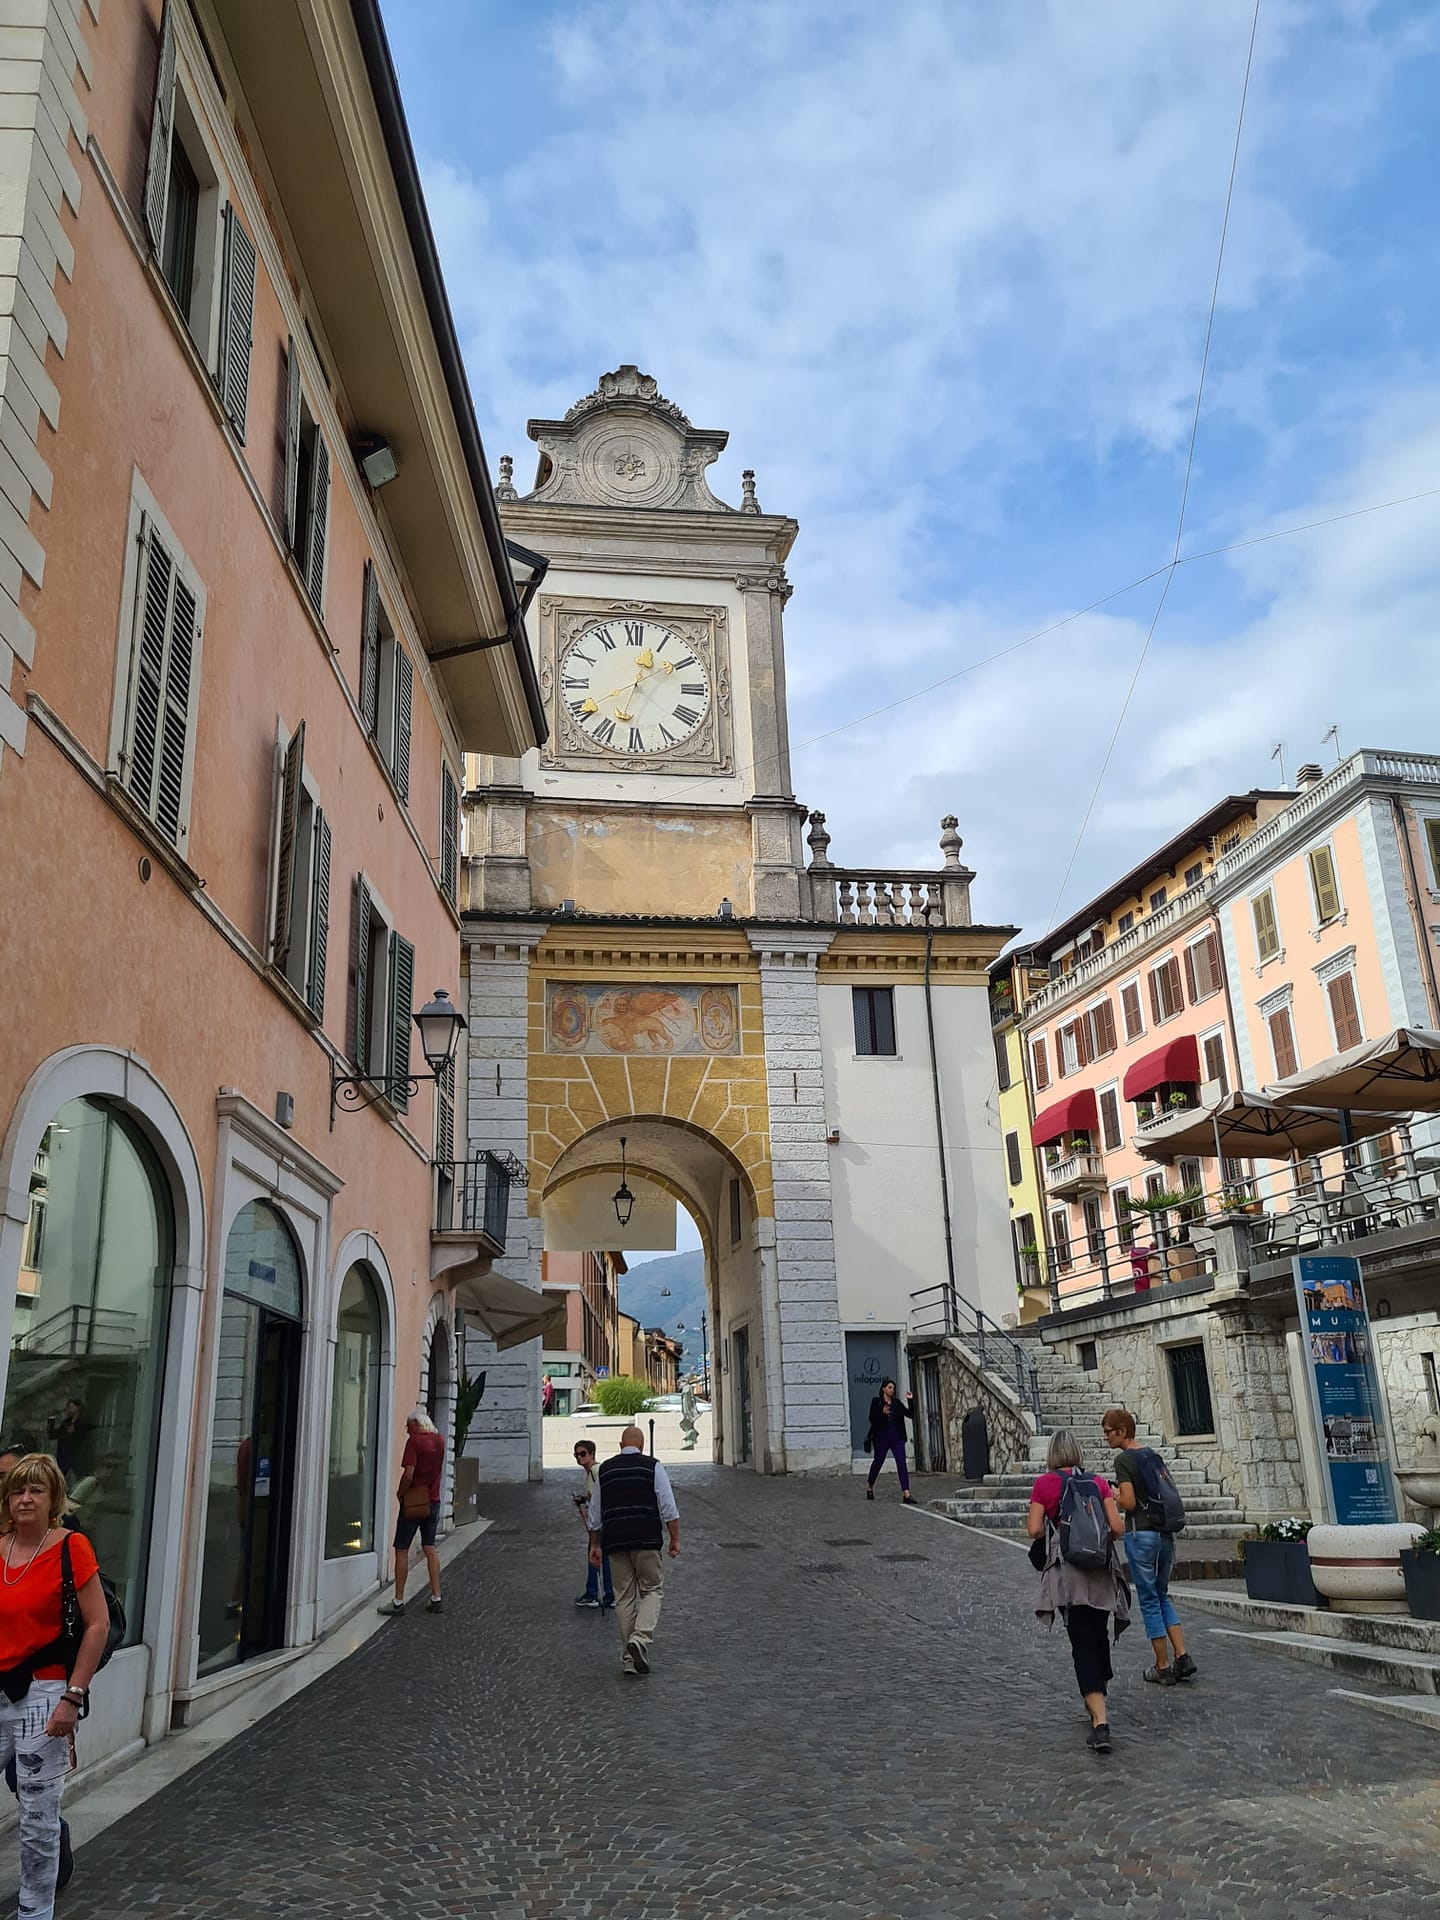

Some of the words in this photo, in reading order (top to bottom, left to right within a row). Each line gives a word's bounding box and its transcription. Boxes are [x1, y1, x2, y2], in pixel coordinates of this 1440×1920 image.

[594, 628, 617, 653] XI
[624, 624, 644, 647] XII
[656, 634, 670, 653] I
[572, 647, 597, 667] X
[674, 655, 697, 671] II
[565, 675, 590, 690] IX
[680, 683, 705, 696] III
[671, 704, 700, 727] IIII
[593, 717, 617, 744] VII
[628, 726, 644, 750] VI
[657, 722, 676, 742] V
